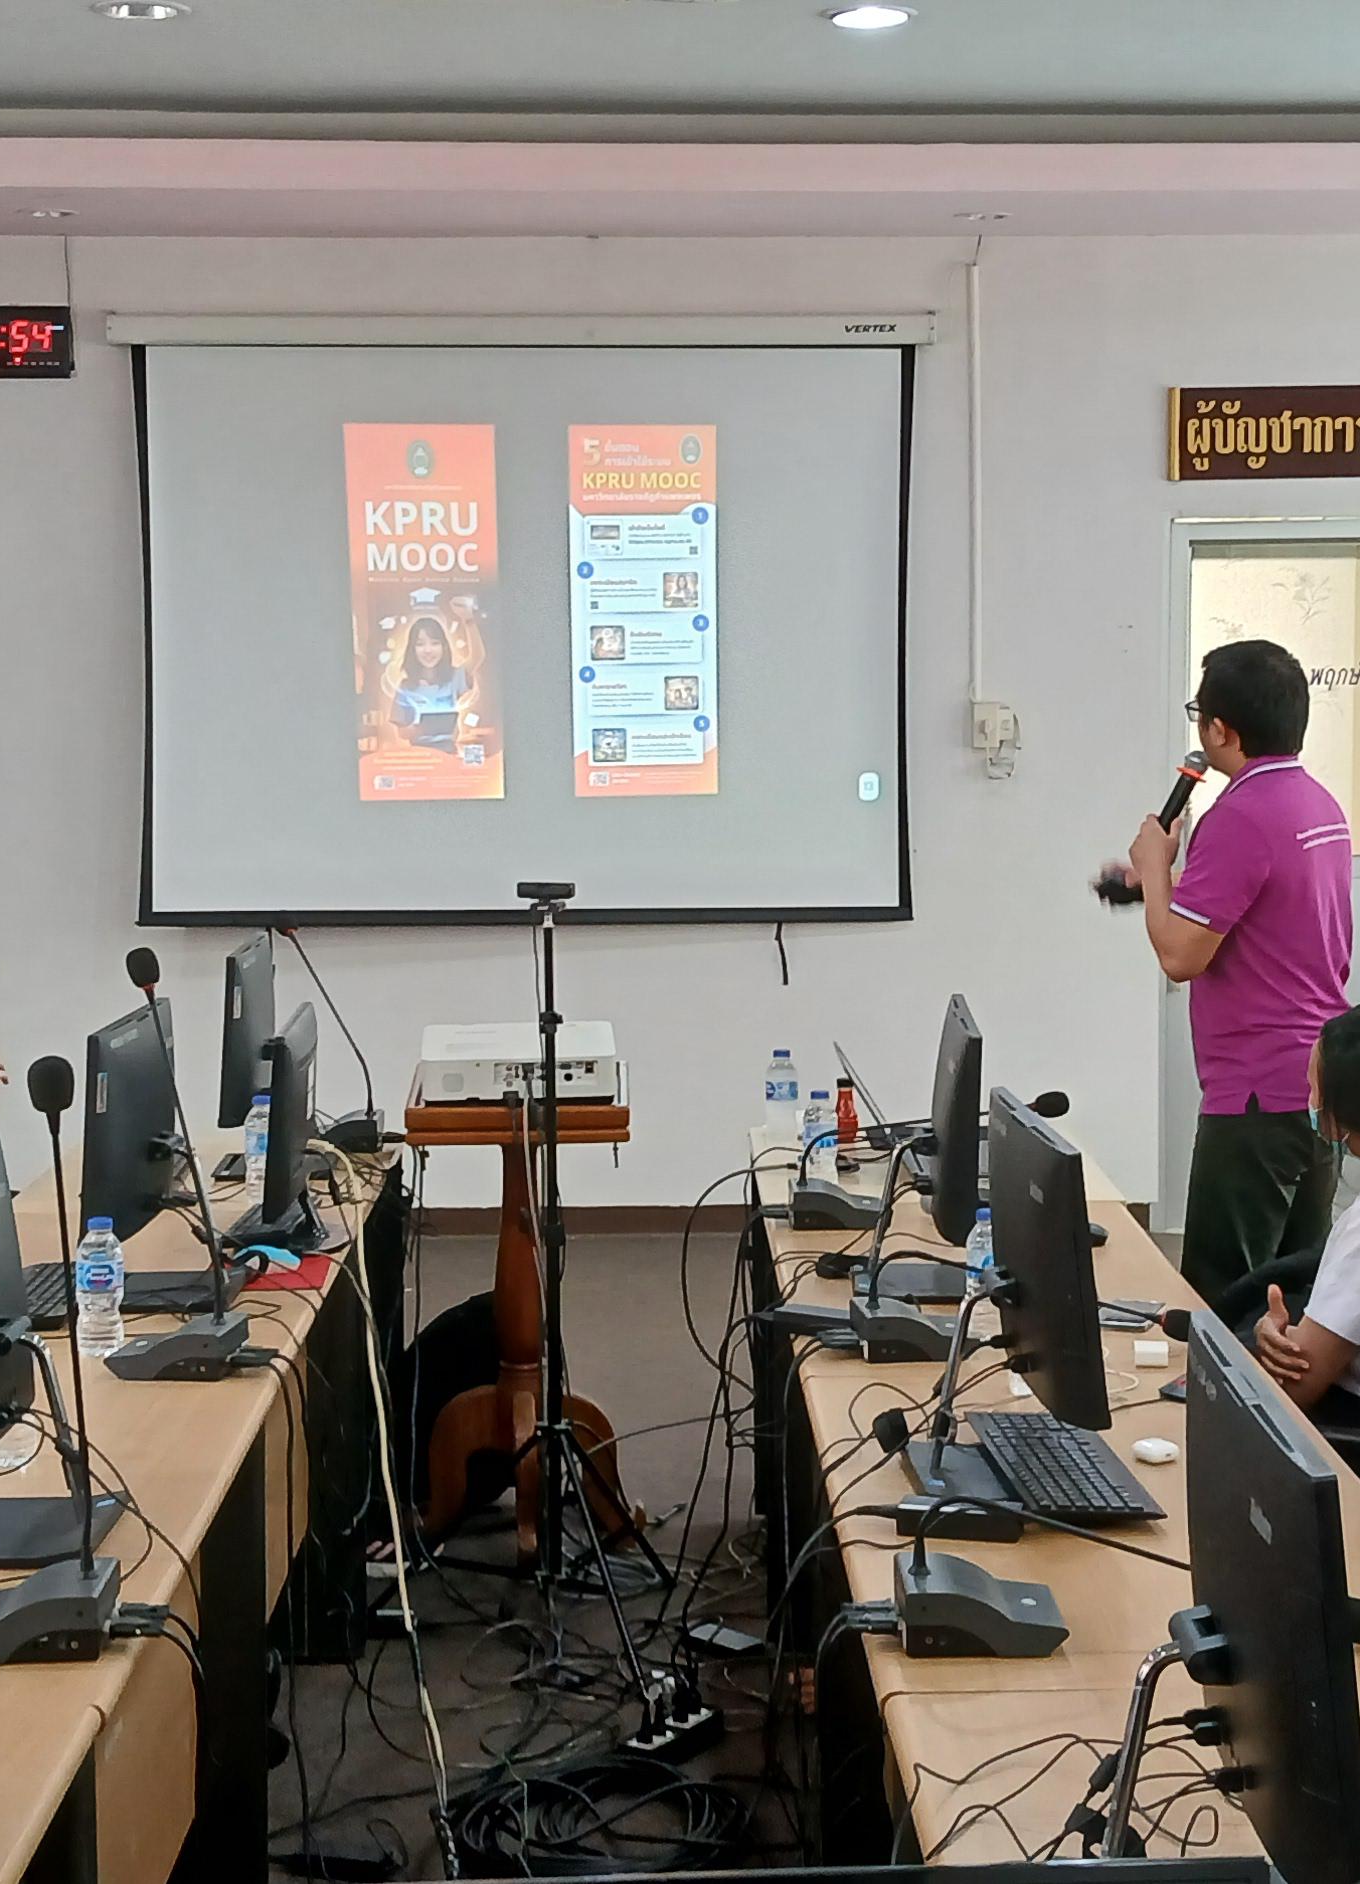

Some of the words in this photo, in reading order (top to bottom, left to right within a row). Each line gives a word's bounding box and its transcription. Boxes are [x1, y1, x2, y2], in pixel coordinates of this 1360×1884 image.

[844, 324, 897, 334] VERTEX
[583, 438, 601, 466] 5
[582, 472, 635, 489] KPRU
[641, 472, 702, 489] MOOC
[364, 500, 479, 537] KPRU
[366, 542, 480, 573] MOOC
